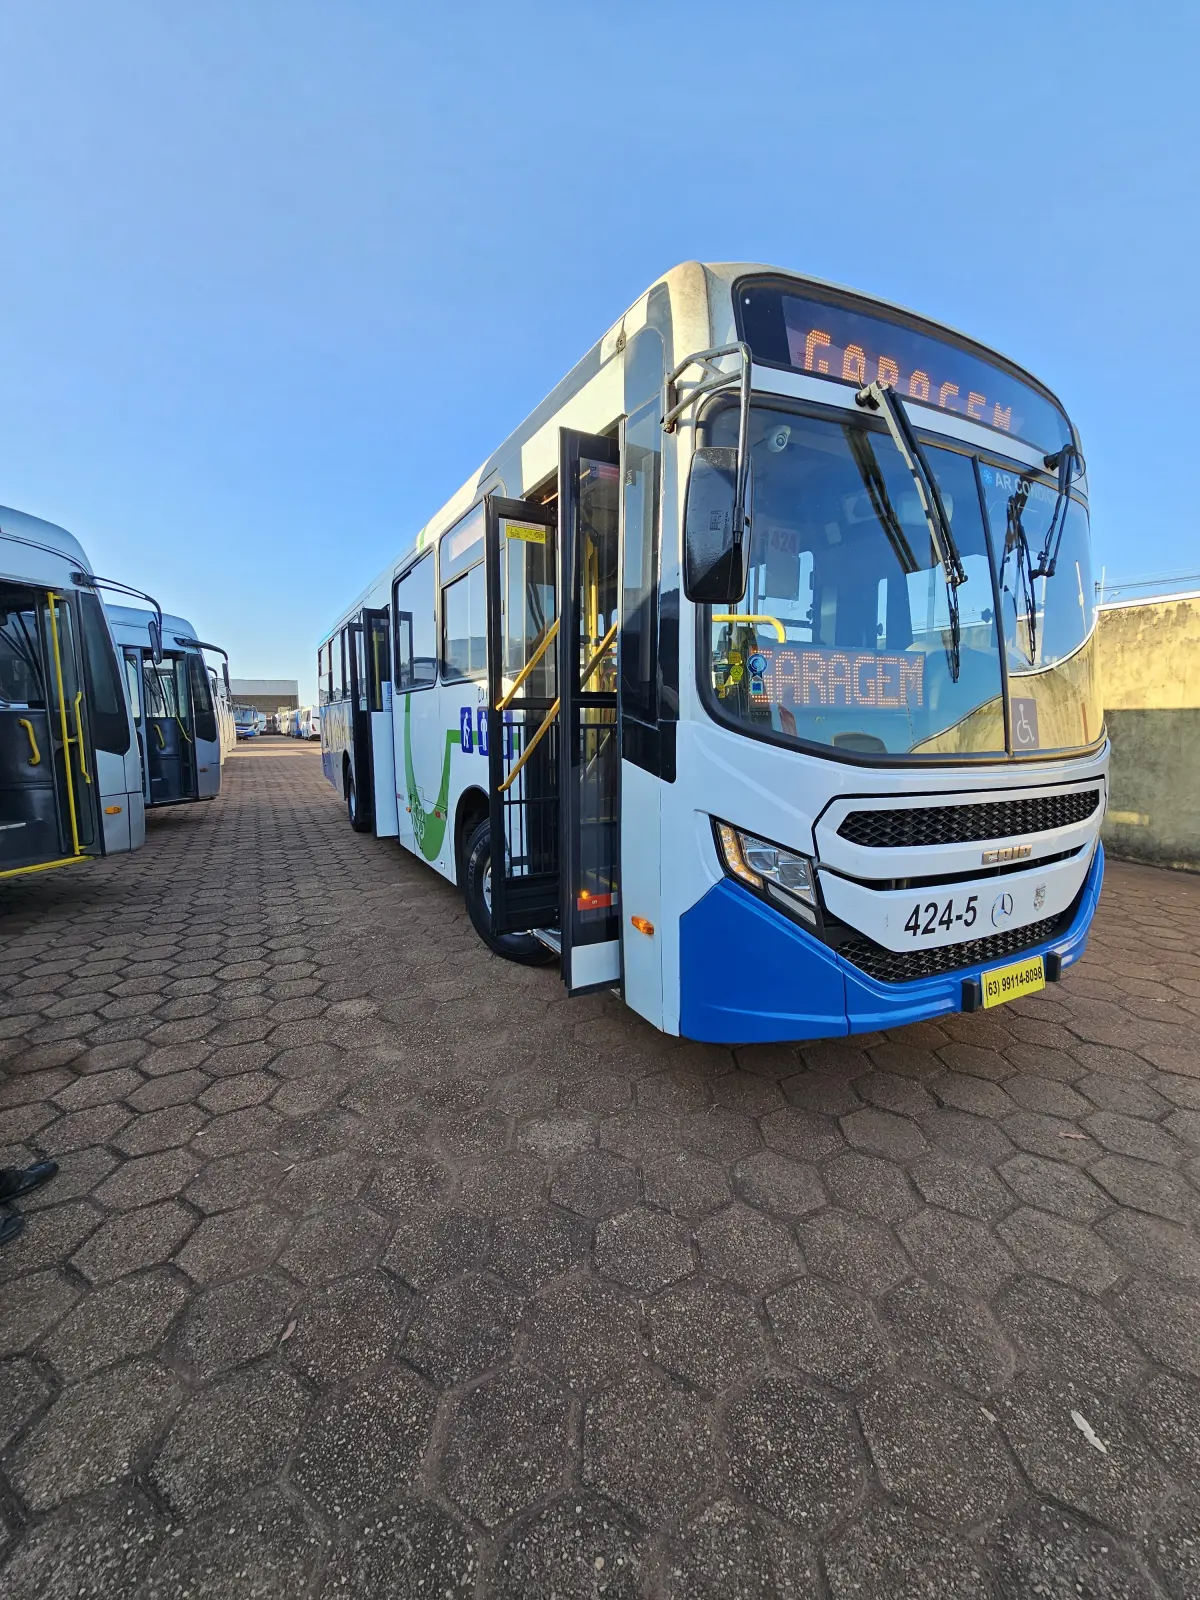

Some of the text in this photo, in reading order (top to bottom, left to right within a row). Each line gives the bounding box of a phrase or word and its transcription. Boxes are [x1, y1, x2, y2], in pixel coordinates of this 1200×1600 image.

[995, 472, 1012, 492] AR
[904, 895, 979, 937] 424-5
[985, 966, 1043, 998] (63) 99114-8098
